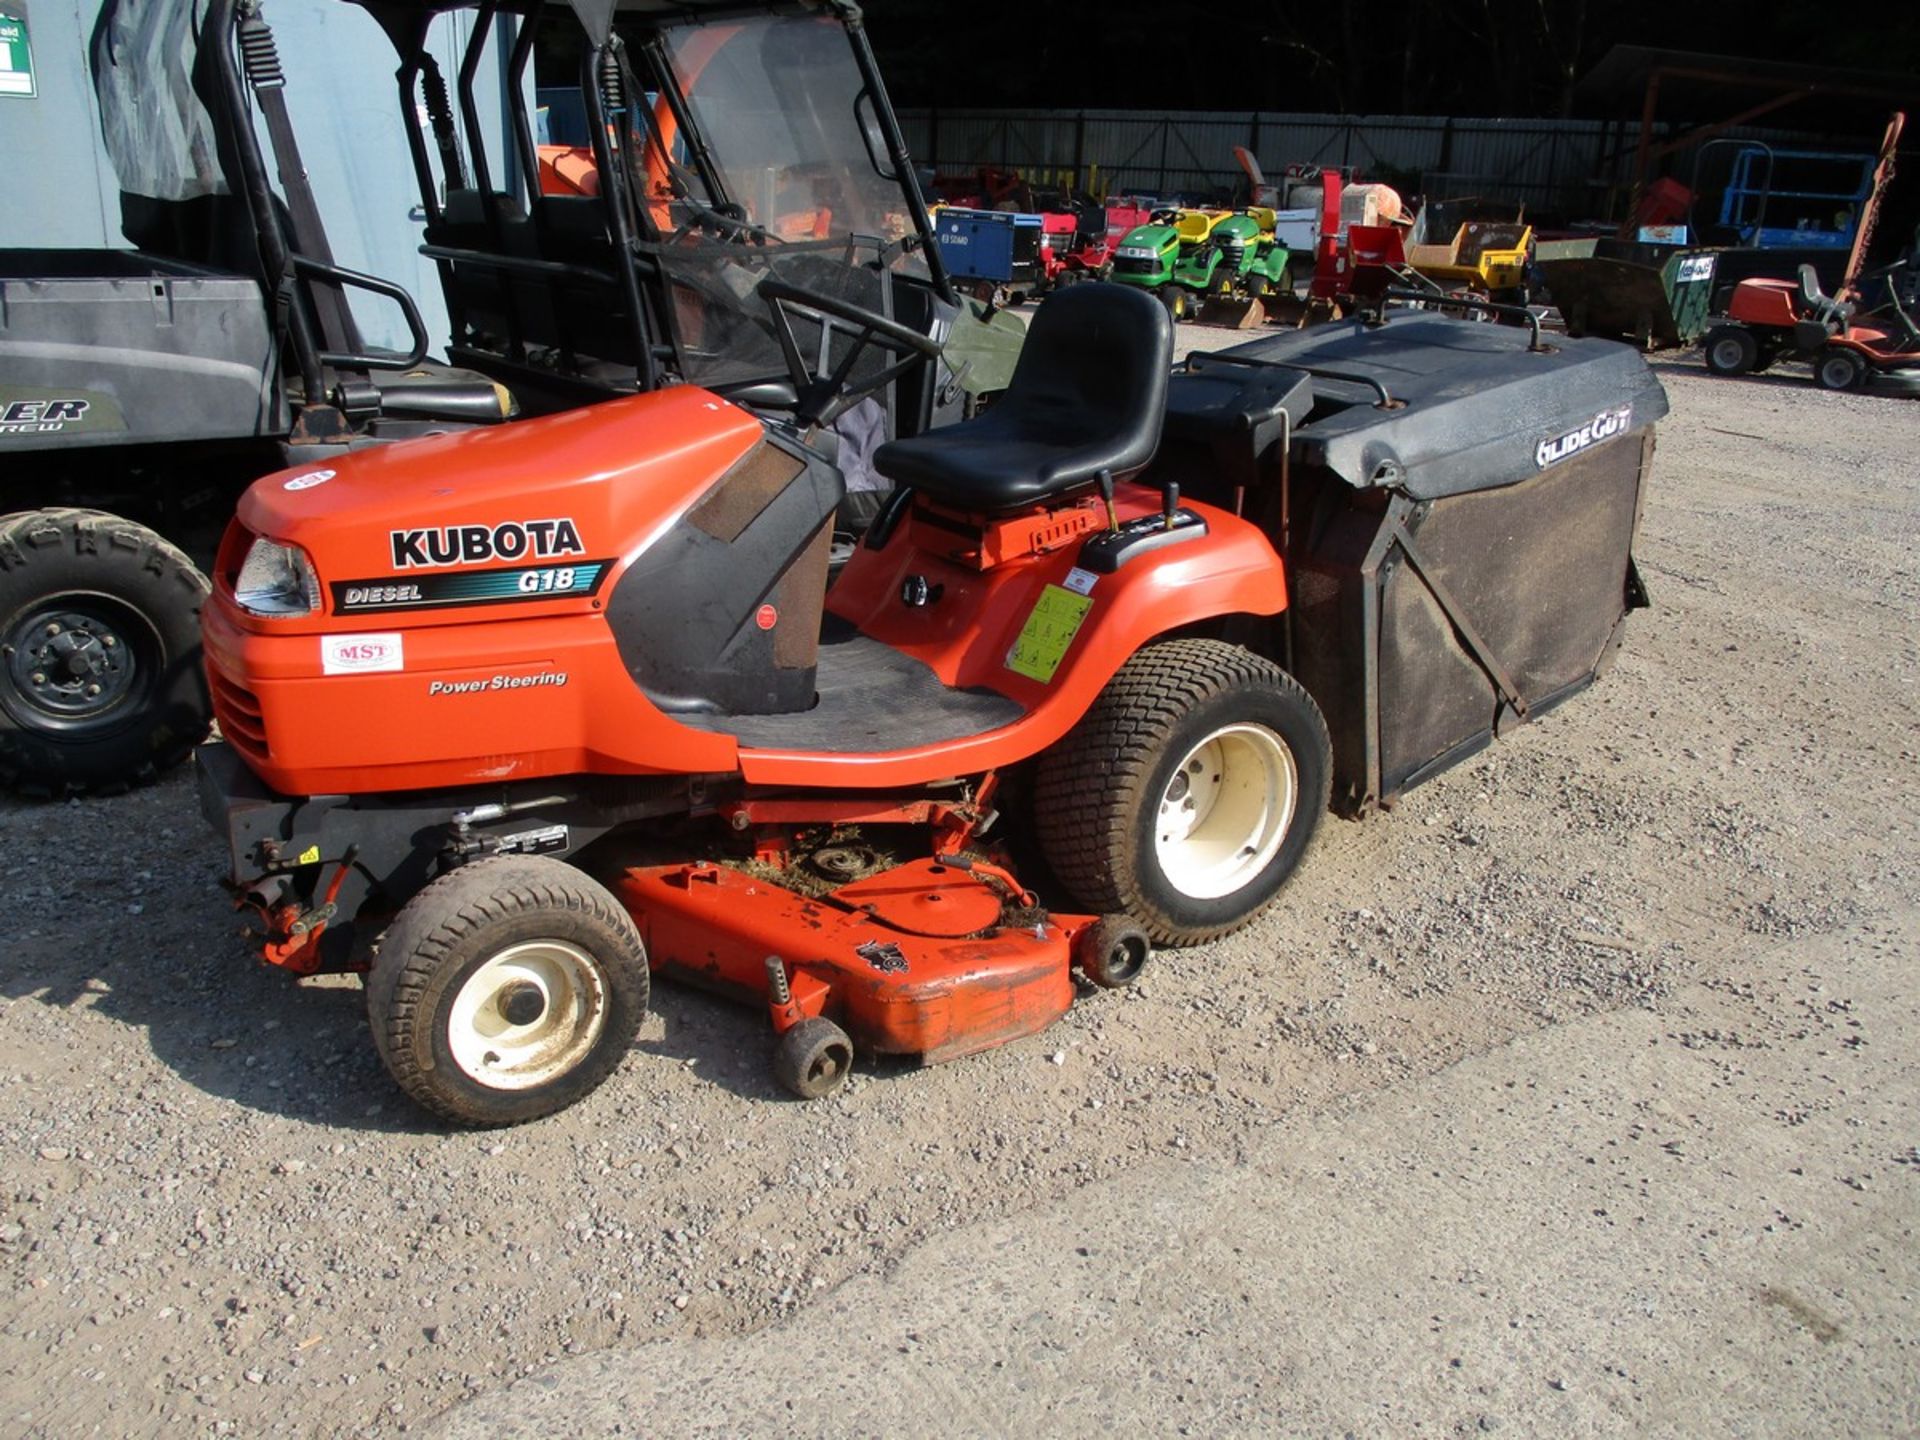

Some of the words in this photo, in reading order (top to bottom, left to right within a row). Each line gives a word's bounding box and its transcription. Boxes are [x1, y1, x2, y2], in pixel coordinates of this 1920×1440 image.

[0, 400, 90, 422] ER
[391, 518, 586, 569] KUBOTA
[344, 584, 423, 604] DIESEL
[518, 567, 576, 593] G18
[339, 644, 387, 660] MST
[429, 680, 490, 695] Power
[490, 672, 568, 690] Steering
